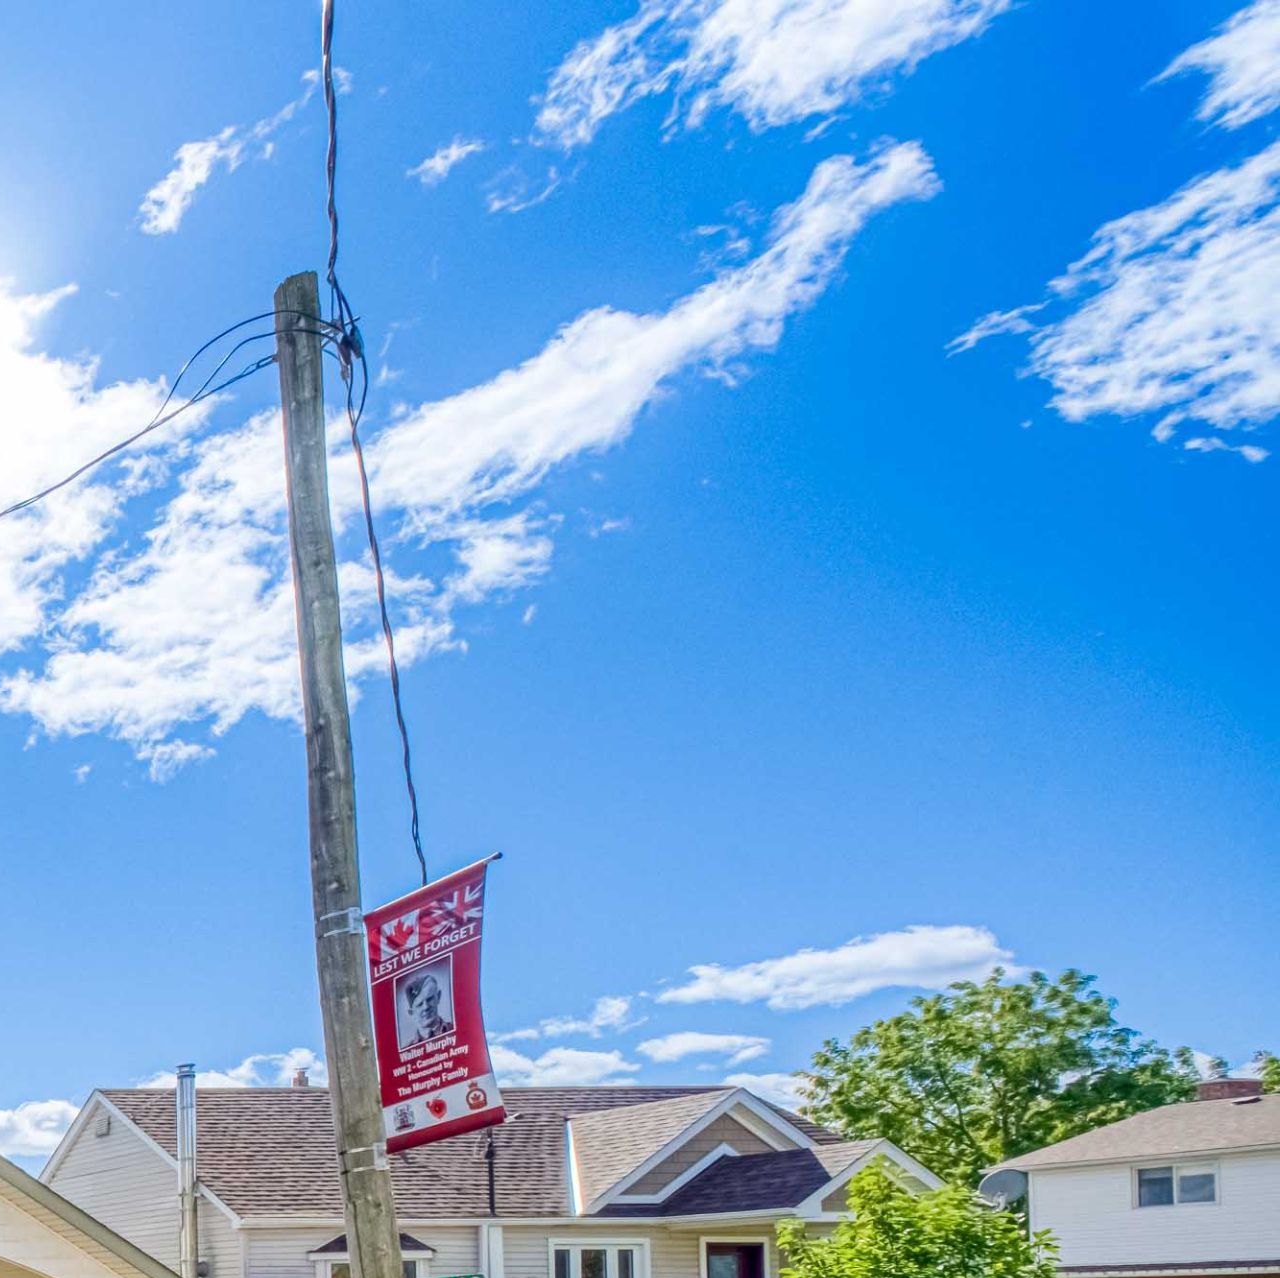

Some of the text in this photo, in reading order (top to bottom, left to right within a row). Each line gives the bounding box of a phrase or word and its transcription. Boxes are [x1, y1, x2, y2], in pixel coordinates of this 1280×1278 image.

[374, 922, 477, 978] LEST WE FORGET
[400, 1035, 457, 1063] Walter Murphy
[416, 1052, 449, 1068] Canadian
[450, 1044, 469, 1058] Army
[397, 1067, 469, 1097] The Murphy Family
[408, 1060, 454, 1081] Honoured by
